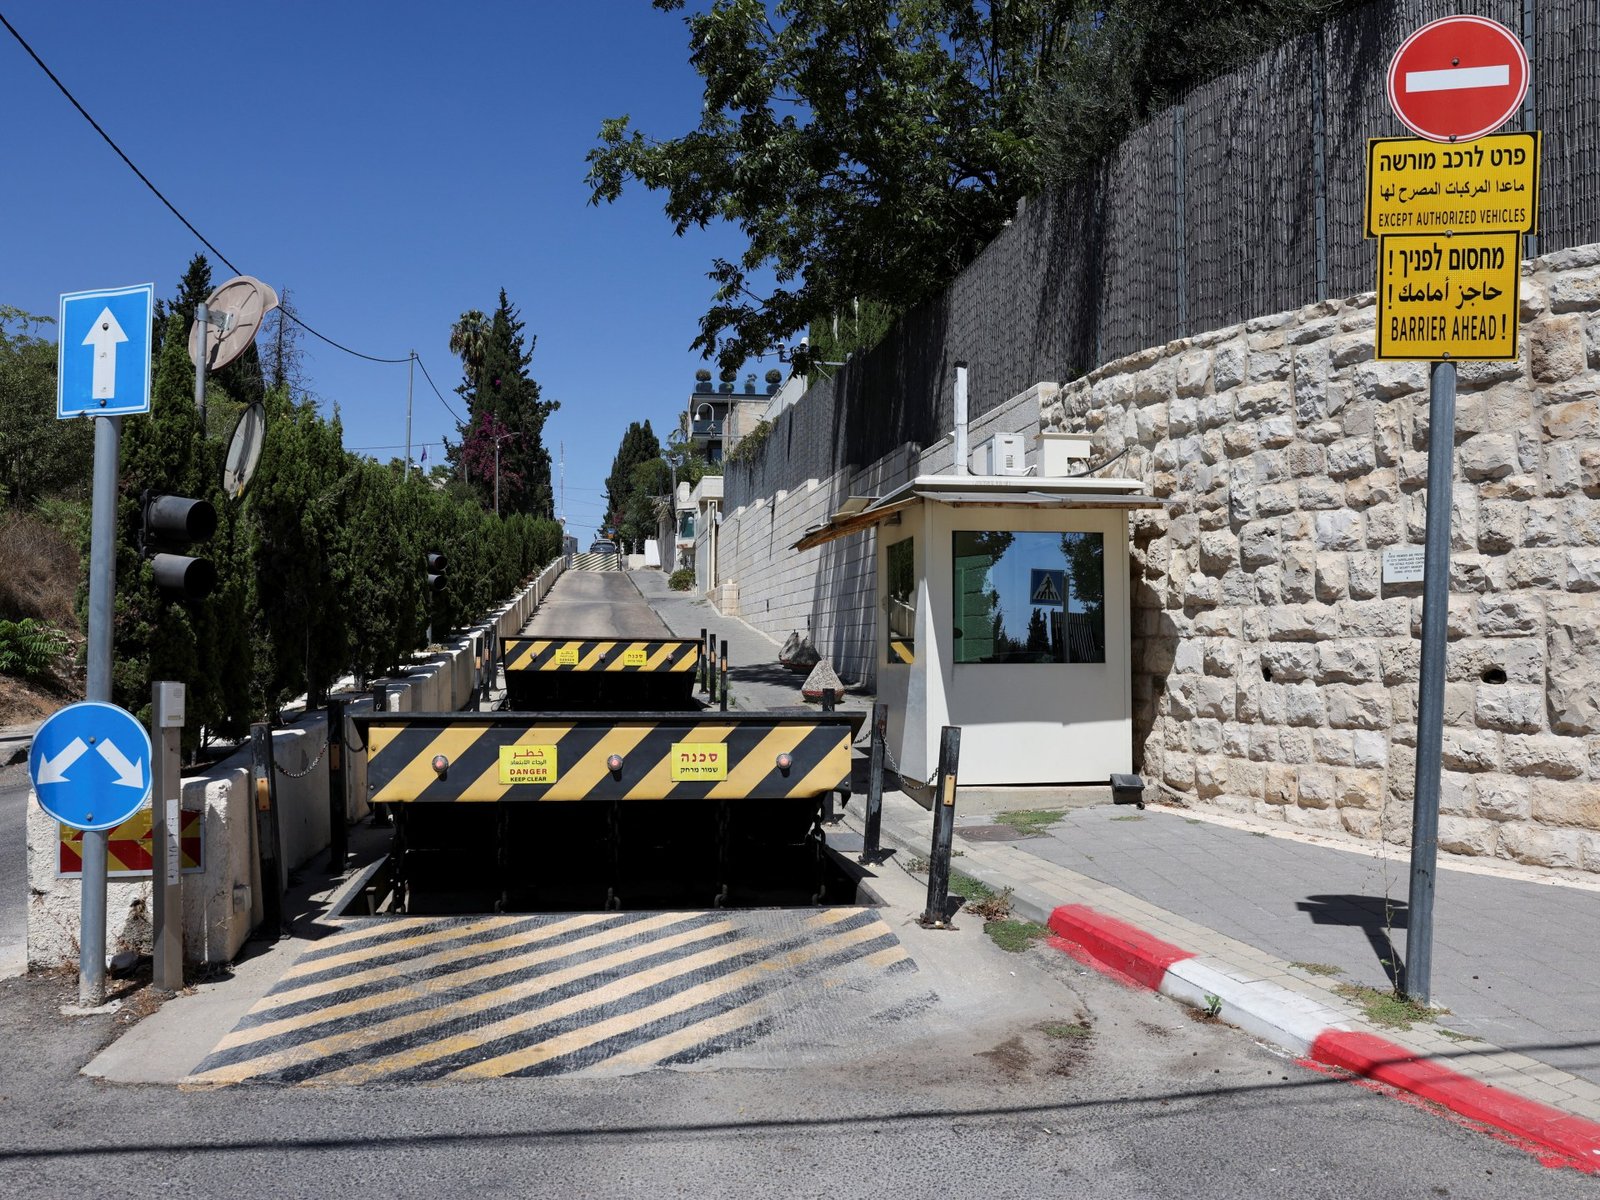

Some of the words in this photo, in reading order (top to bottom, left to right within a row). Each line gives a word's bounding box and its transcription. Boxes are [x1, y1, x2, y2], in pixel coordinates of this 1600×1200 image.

[1380, 152, 1436, 172] מורשה
[1442, 144, 1484, 169] לרכב
[1490, 147, 1526, 167] פרט
[1380, 183, 1395, 202] لها
[1398, 181, 1441, 203] المصرح
[1445, 180, 1491, 198] المركبات
[1496, 178, 1525, 193] ماعدا
[1378, 212, 1413, 227] EXCEPT
[1416, 210, 1477, 226] AUTHORIZED
[1480, 208, 1526, 224] VEHICLES
[1448, 246, 1505, 271] מחסום
[1455, 280, 1503, 310] حاجز
[1391, 316, 1447, 341] BARRIER
[513, 748, 544, 759] خطر
[680, 752, 718, 763] סכנה
